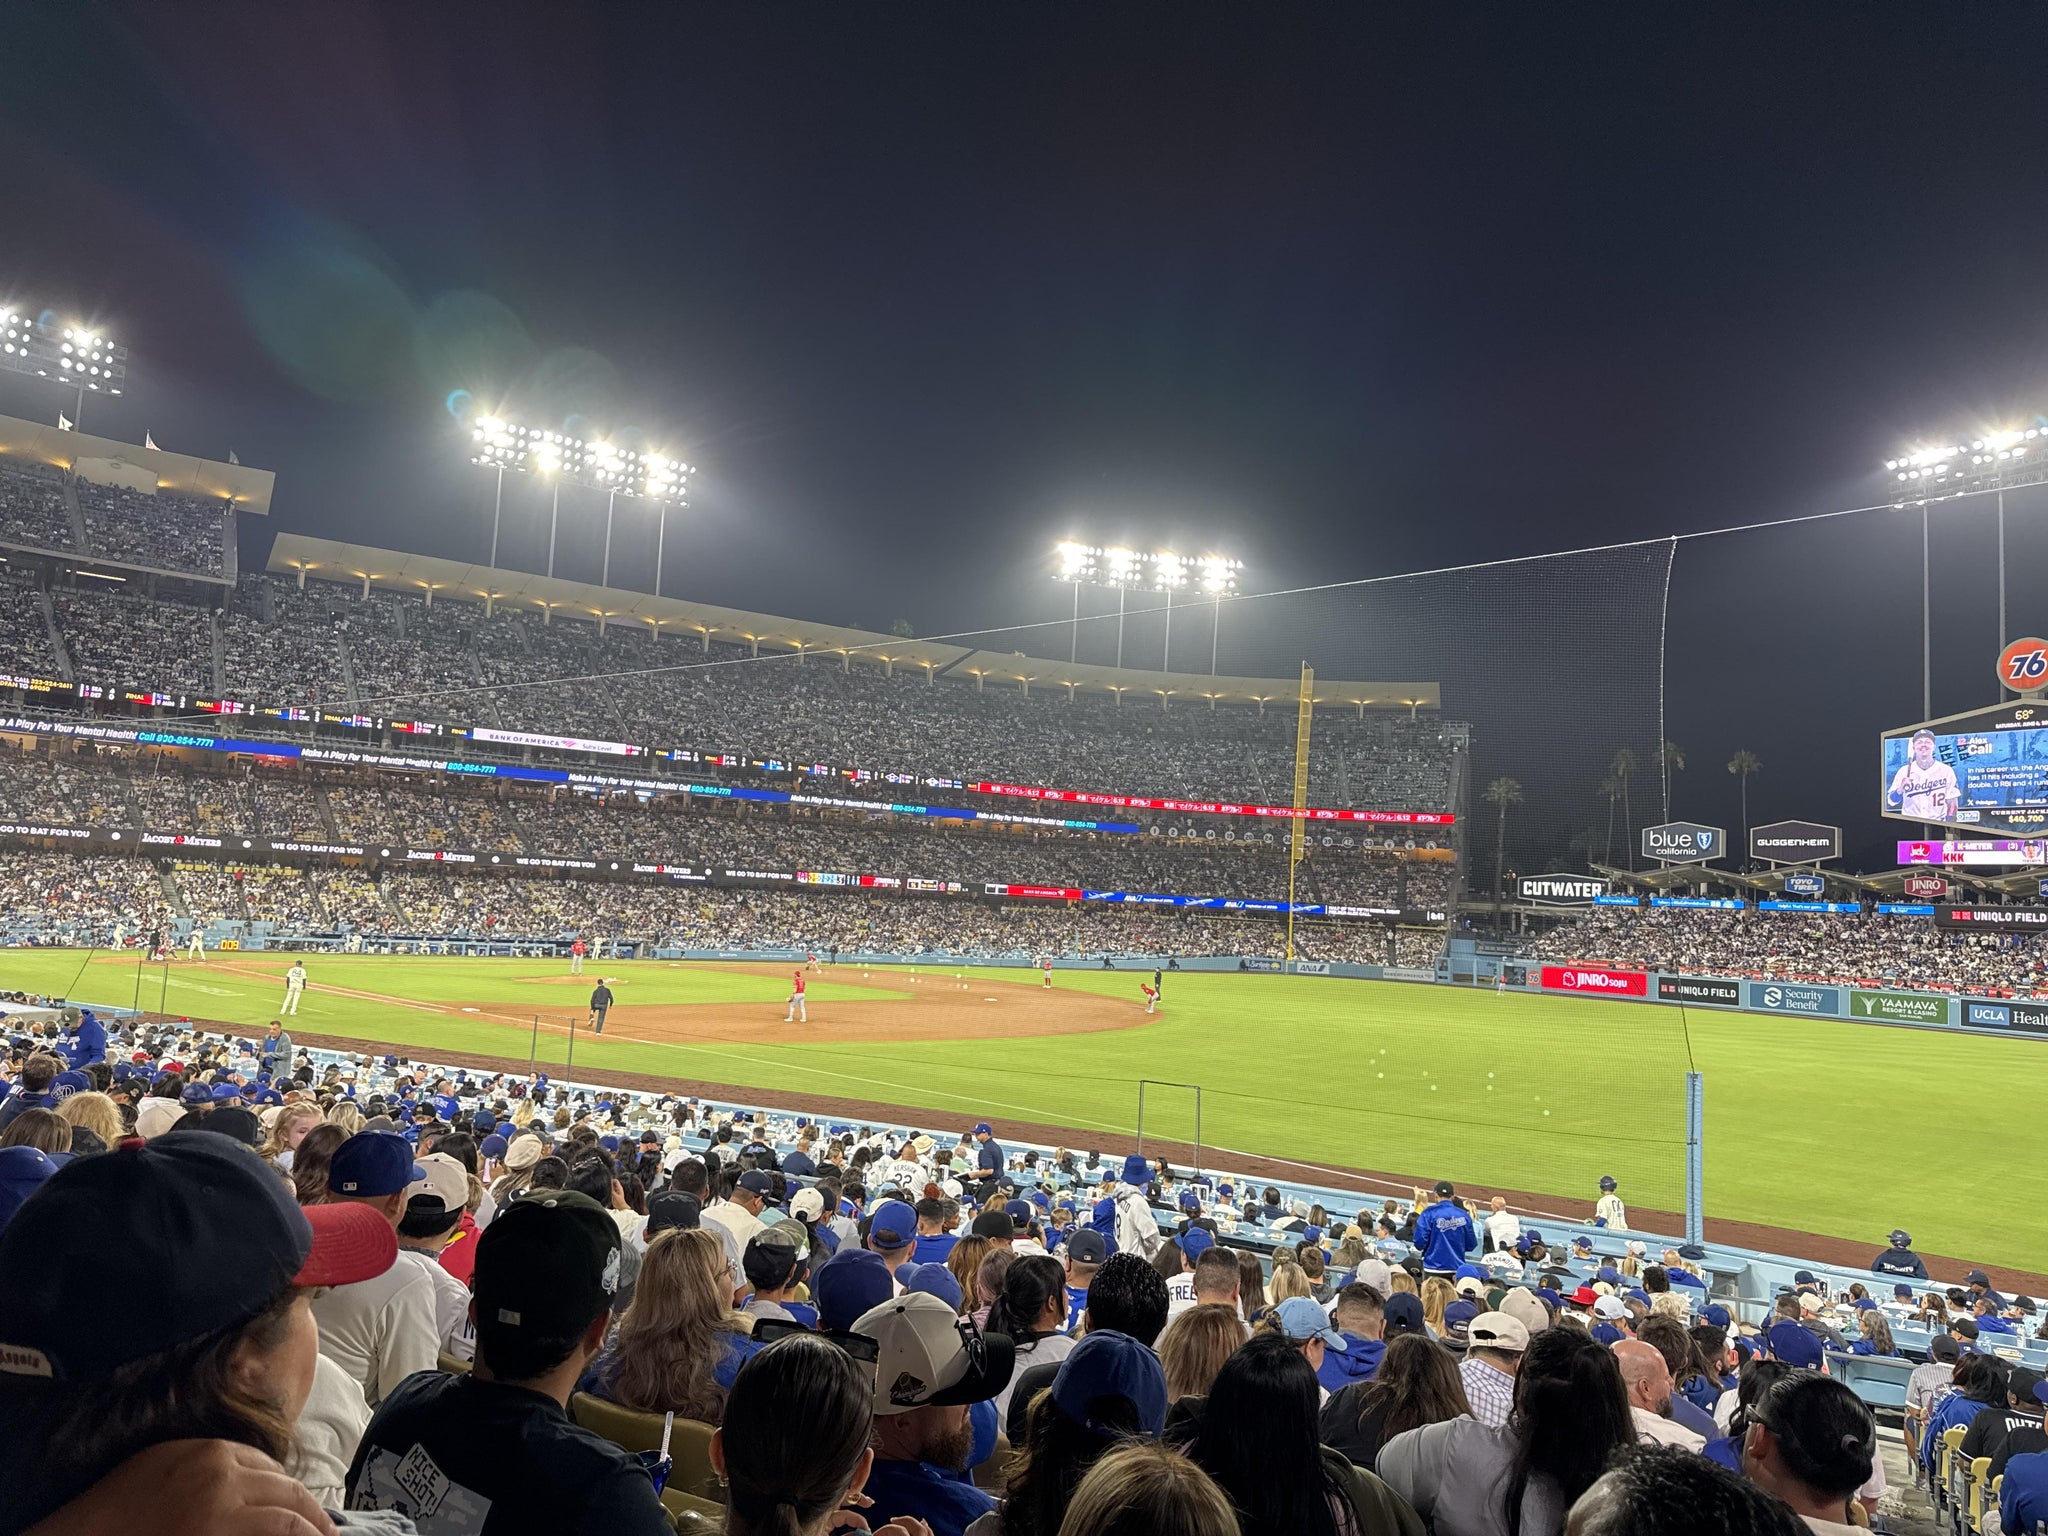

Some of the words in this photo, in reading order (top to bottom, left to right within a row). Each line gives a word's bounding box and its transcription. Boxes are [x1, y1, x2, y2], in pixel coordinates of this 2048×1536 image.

[2009, 649, 2047, 679] 76
[126, 692, 144, 700] FINAL
[196, 700, 214, 708] FINAL
[6, 718, 14, 727] A
[15, 719, 36, 731] Play
[37, 721, 52, 731] For
[53, 722, 74, 734] Your
[74, 726, 106, 738] Mental
[106, 729, 138, 741] Health!
[139, 732, 155, 742] Call
[156, 734, 214, 748] 800-854-7771
[451, 728, 467, 736] FINAL
[489, 734, 511, 742] BANK
[525, 738, 560, 747] AMERICA
[1968, 743, 1993, 756] Call
[301, 748, 321, 758] Make
[330, 751, 347, 762] Play
[348, 753, 361, 762] For
[362, 754, 379, 764] Your
[379, 755, 405, 766] Mental
[433, 761, 447, 770] Call
[447, 762, 496, 774] 800-854-7771
[2002, 772, 2033, 780] including
[1903, 777, 1947, 796] Dodgers
[1932, 793, 1946, 807] 12
[2008, 814, 2045, 823] $40,700
[0, 825, 14, 833] GO
[16, 826, 28, 834] TO
[30, 827, 48, 835] BAT
[50, 829, 69, 837] FOR
[70, 830, 90, 838] YOU
[1650, 830, 1692, 847] blue
[1757, 838, 1830, 847] GUGGENHEIM
[271, 842, 285, 850] WE
[286, 843, 299, 851] GO
[1656, 847, 1697, 856] california
[2007, 842, 2018, 850] (3)
[516, 857, 529, 865] WE
[530, 858, 540, 866] GO
[541, 859, 551, 867] TO
[551, 860, 566, 868] BAT
[1523, 881, 1602, 898] CUTWATER
[1912, 880, 1941, 891] JINRO
[1974, 911, 2012, 922] UNIQLO
[2015, 912, 2047, 923] FIELD
[1529, 974, 1539, 982] 76
[1576, 972, 1608, 988] JINRO
[1711, 988, 1737, 998] FIELD
[1785, 988, 1823, 1002] Security
[1786, 999, 1818, 1011] Benefit
[1882, 1007, 1906, 1015] RESORT
[1975, 1009, 2005, 1021] UCLA
[894, 1165, 918, 1175] KERSHAW
[895, 1173, 913, 1187] 22
[1436, 1215, 1467, 1233] Dodgers
[407, 1446, 441, 1488] NICE
[402, 1468, 438, 1512] SHOT!
